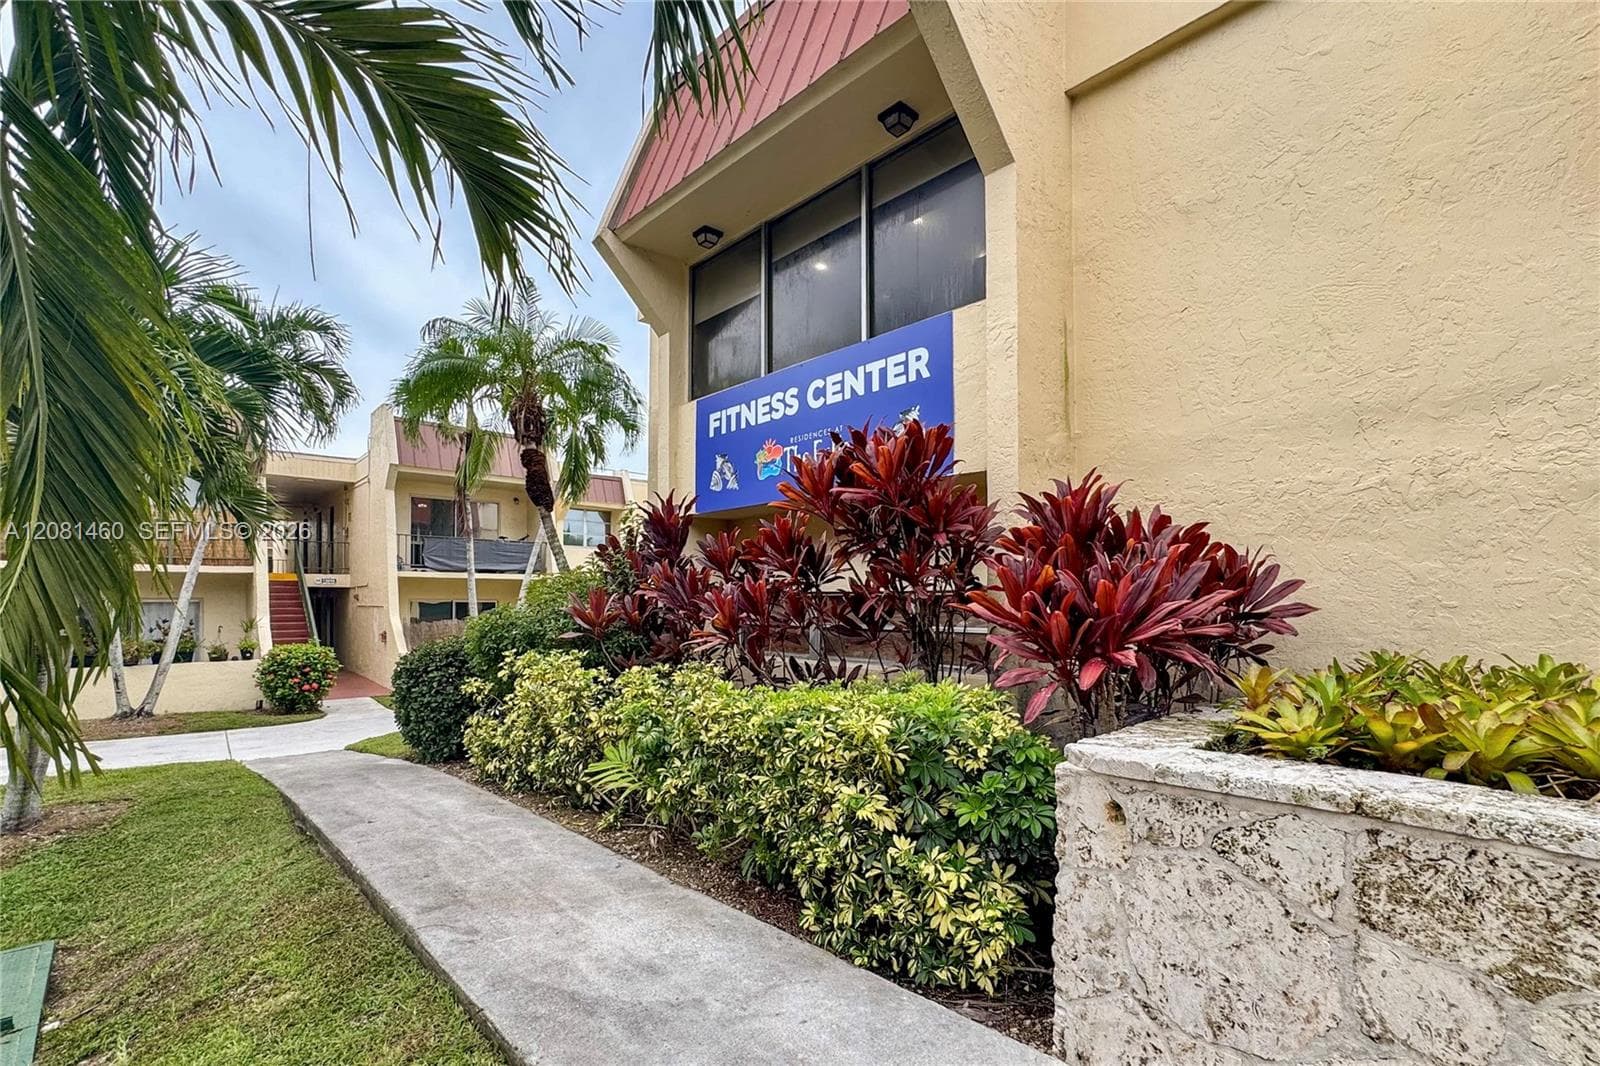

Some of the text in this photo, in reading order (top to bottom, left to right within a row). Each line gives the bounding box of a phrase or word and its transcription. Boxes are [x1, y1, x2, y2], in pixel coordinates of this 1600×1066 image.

[708, 347, 931, 438] FITNESS CENTER
[834, 424, 843, 433] AT
